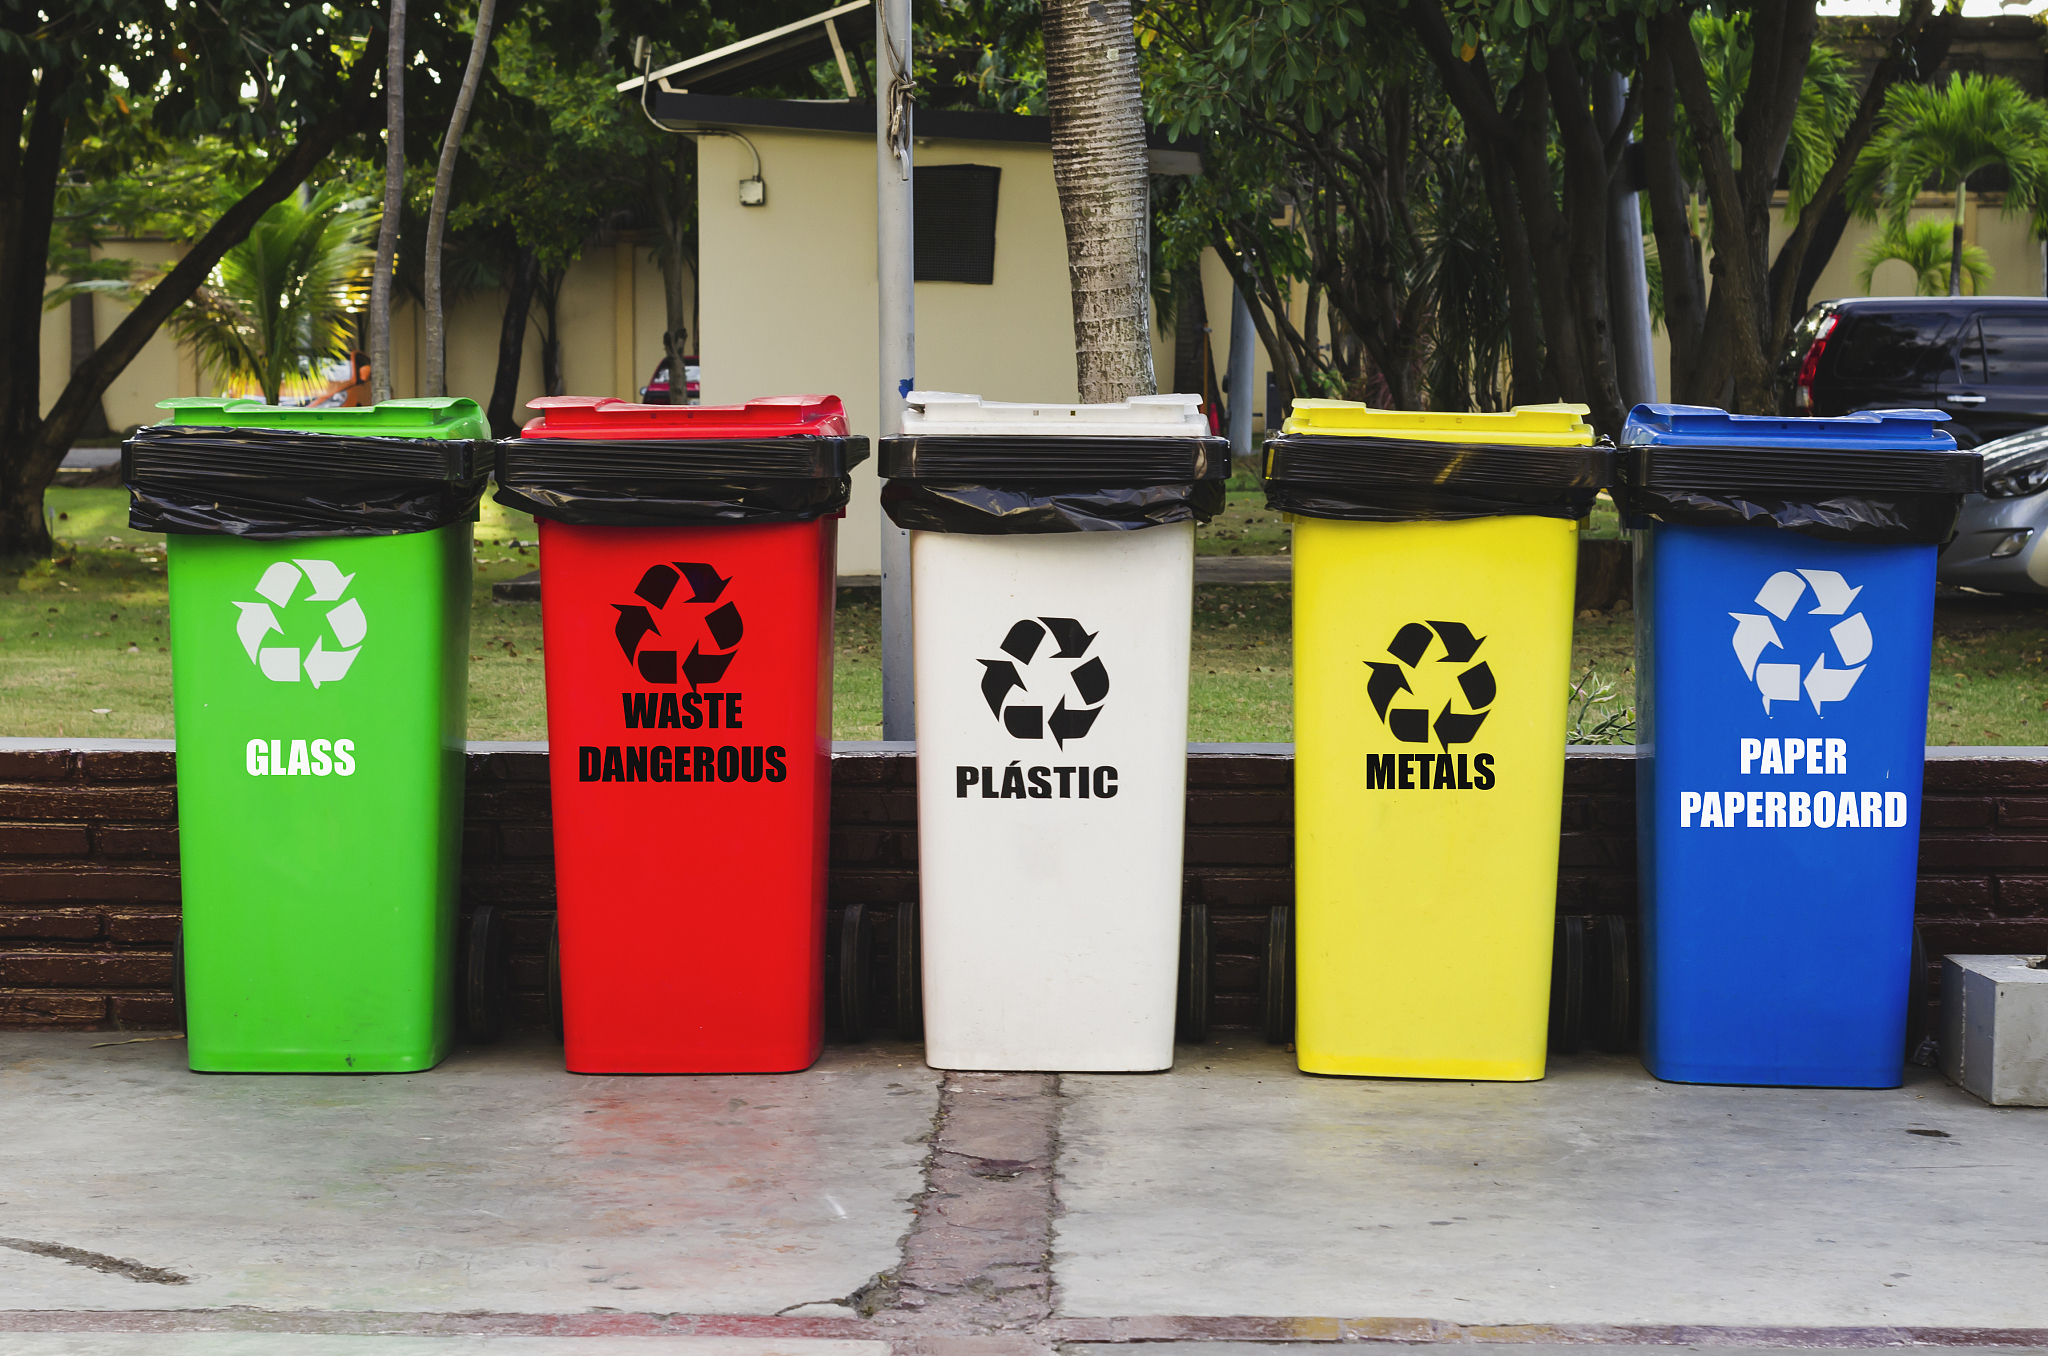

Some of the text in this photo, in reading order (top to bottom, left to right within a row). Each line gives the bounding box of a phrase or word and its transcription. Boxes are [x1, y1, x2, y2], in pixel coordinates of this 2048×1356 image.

[621, 691, 743, 730] WASTE
[246, 738, 356, 777] GLASS
[579, 745, 787, 783] DANGEROUS
[1366, 752, 1496, 791] METALS
[1740, 737, 1847, 775] PAPER
[956, 760, 1118, 800] PLÁSTIC
[1680, 790, 1907, 829] PAPERBOARD
